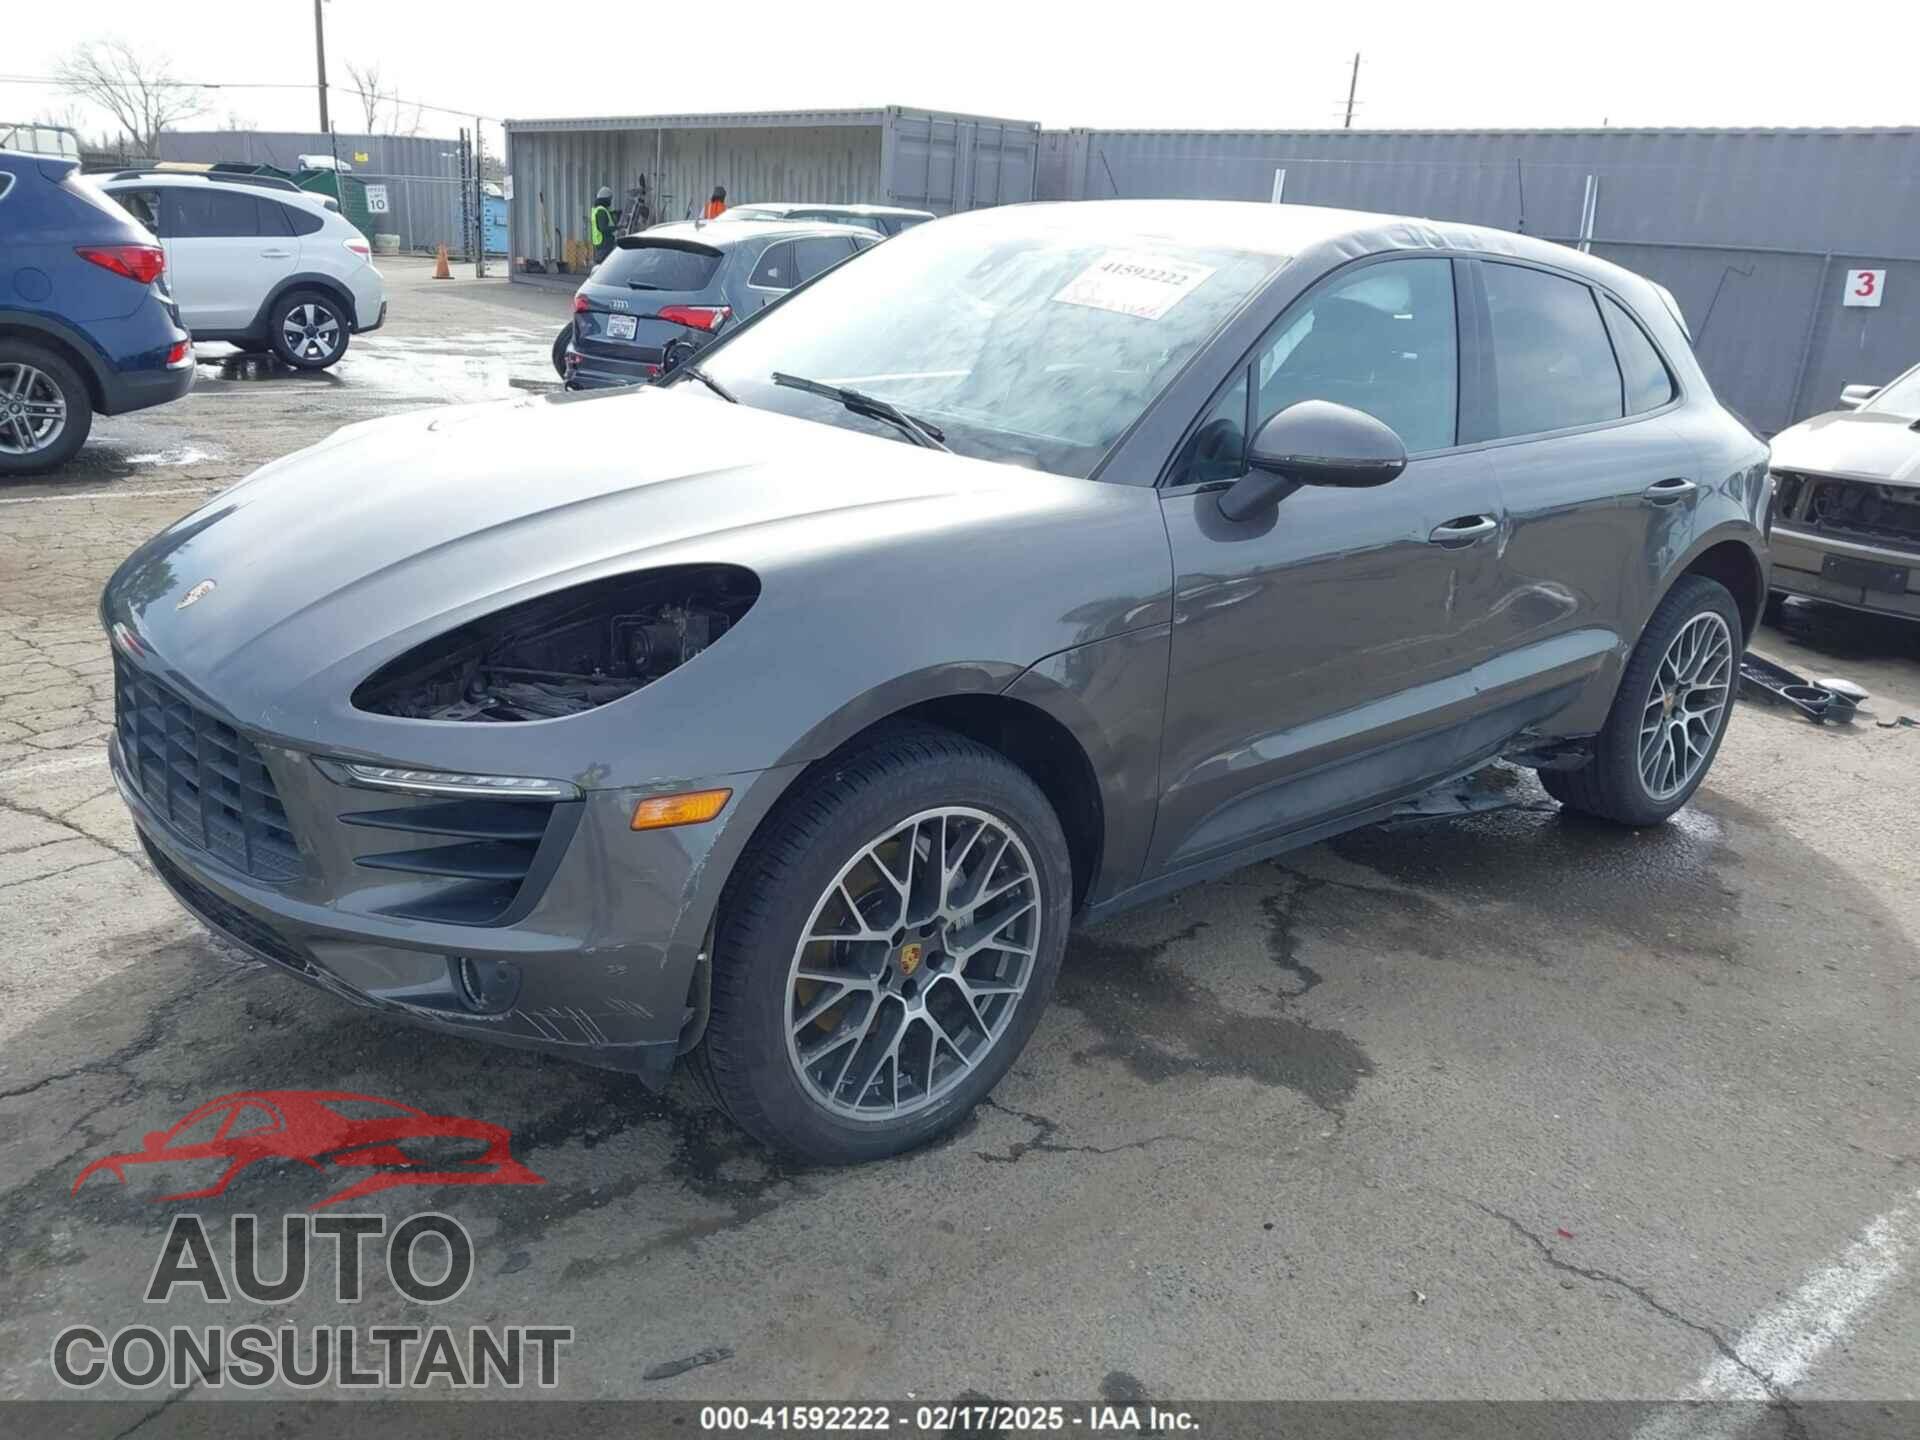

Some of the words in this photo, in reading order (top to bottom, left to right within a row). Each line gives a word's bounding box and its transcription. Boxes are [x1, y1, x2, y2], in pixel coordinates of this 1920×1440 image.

[371, 200, 385, 210] 10
[1102, 262, 1189, 286] 41592222
[1855, 272, 1875, 297] 3
